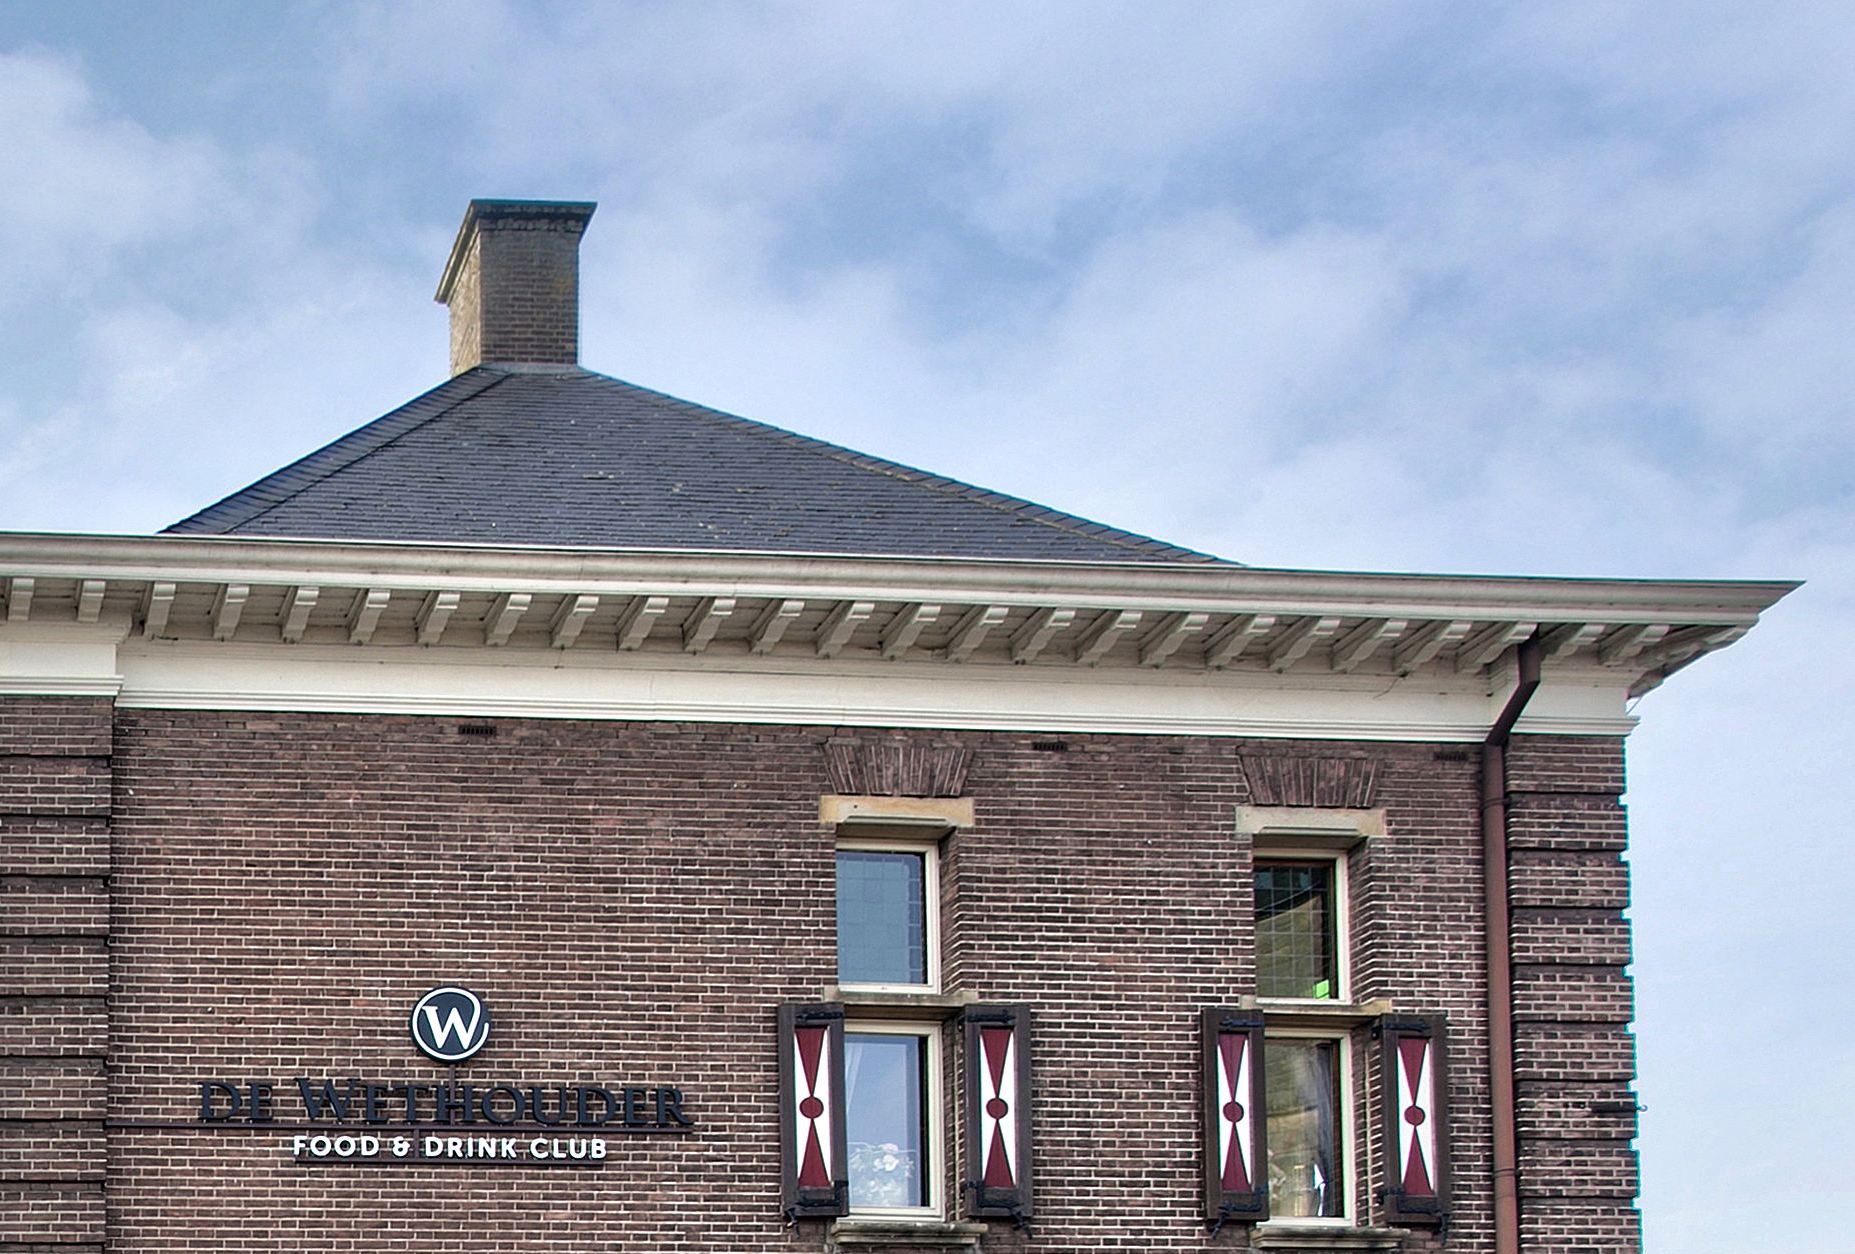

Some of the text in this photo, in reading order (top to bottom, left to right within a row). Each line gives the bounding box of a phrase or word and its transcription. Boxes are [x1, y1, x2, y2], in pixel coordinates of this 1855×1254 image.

[421, 992, 483, 1052] W
[197, 1076, 694, 1127] DE WETHOUDER
[293, 1134, 608, 1160] FOOD & DRINK CLUB
